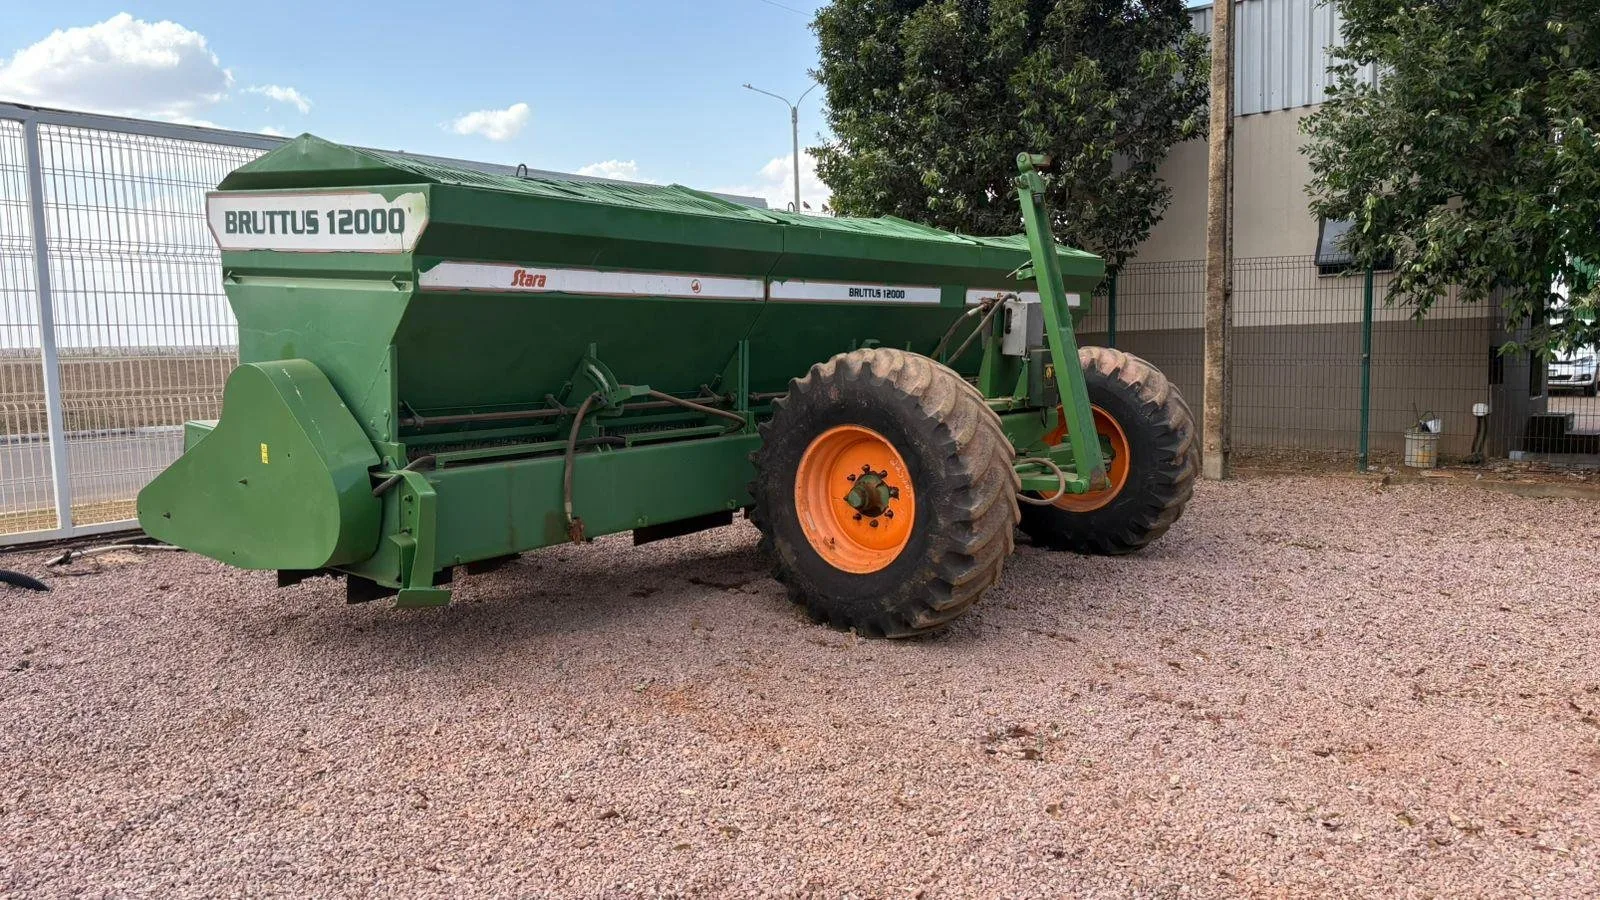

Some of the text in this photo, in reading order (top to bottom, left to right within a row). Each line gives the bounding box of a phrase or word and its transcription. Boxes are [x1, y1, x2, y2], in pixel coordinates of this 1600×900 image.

[225, 207, 405, 235] BRUTTUS 12000
[511, 269, 547, 288] Stara
[849, 288, 905, 300] BRUTTUS 12000
